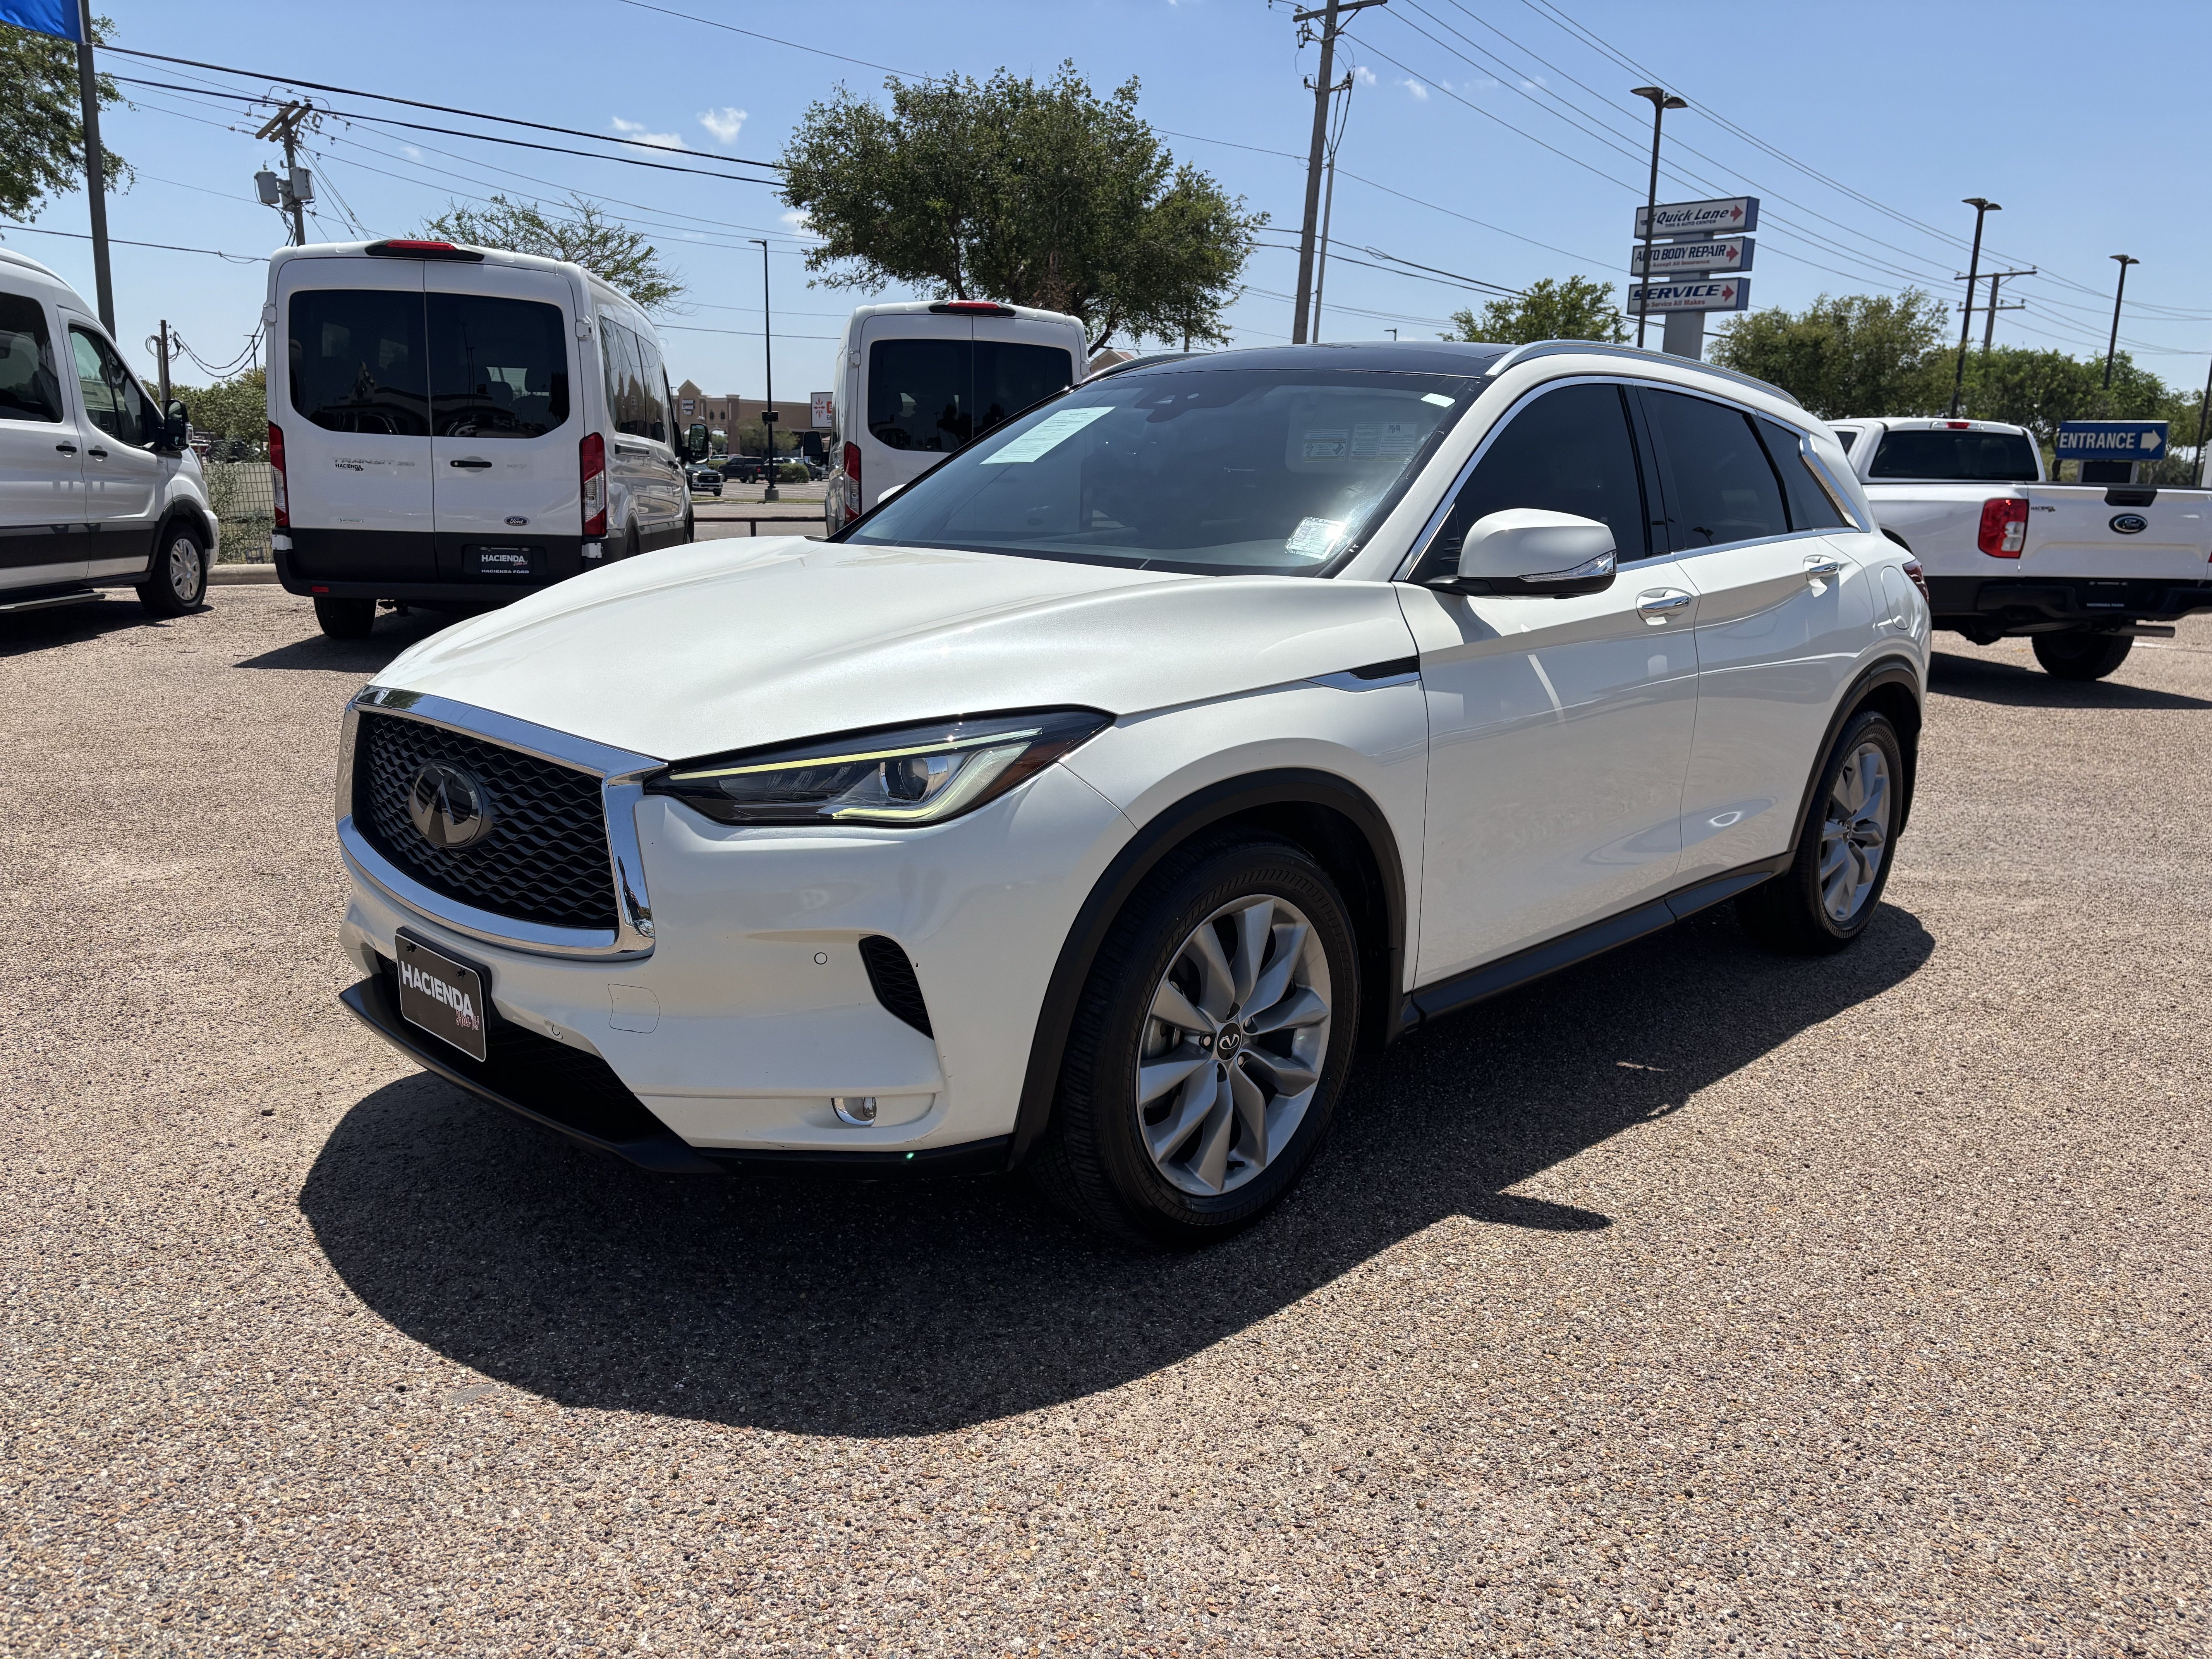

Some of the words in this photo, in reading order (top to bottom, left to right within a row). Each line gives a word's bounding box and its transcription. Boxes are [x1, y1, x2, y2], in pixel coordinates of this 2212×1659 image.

[1656, 209, 1692, 225] Quick
[1694, 208, 1729, 220] Lane
[1635, 249, 1660, 262] ATO
[1661, 247, 1688, 260] BODY
[1688, 244, 1726, 259] REPAIR
[1632, 284, 1721, 301] SERVICE
[2059, 432, 2136, 449] ENTRANCE
[481, 555, 525, 563] HACIENDA
[401, 960, 474, 1020] HACIENDA
